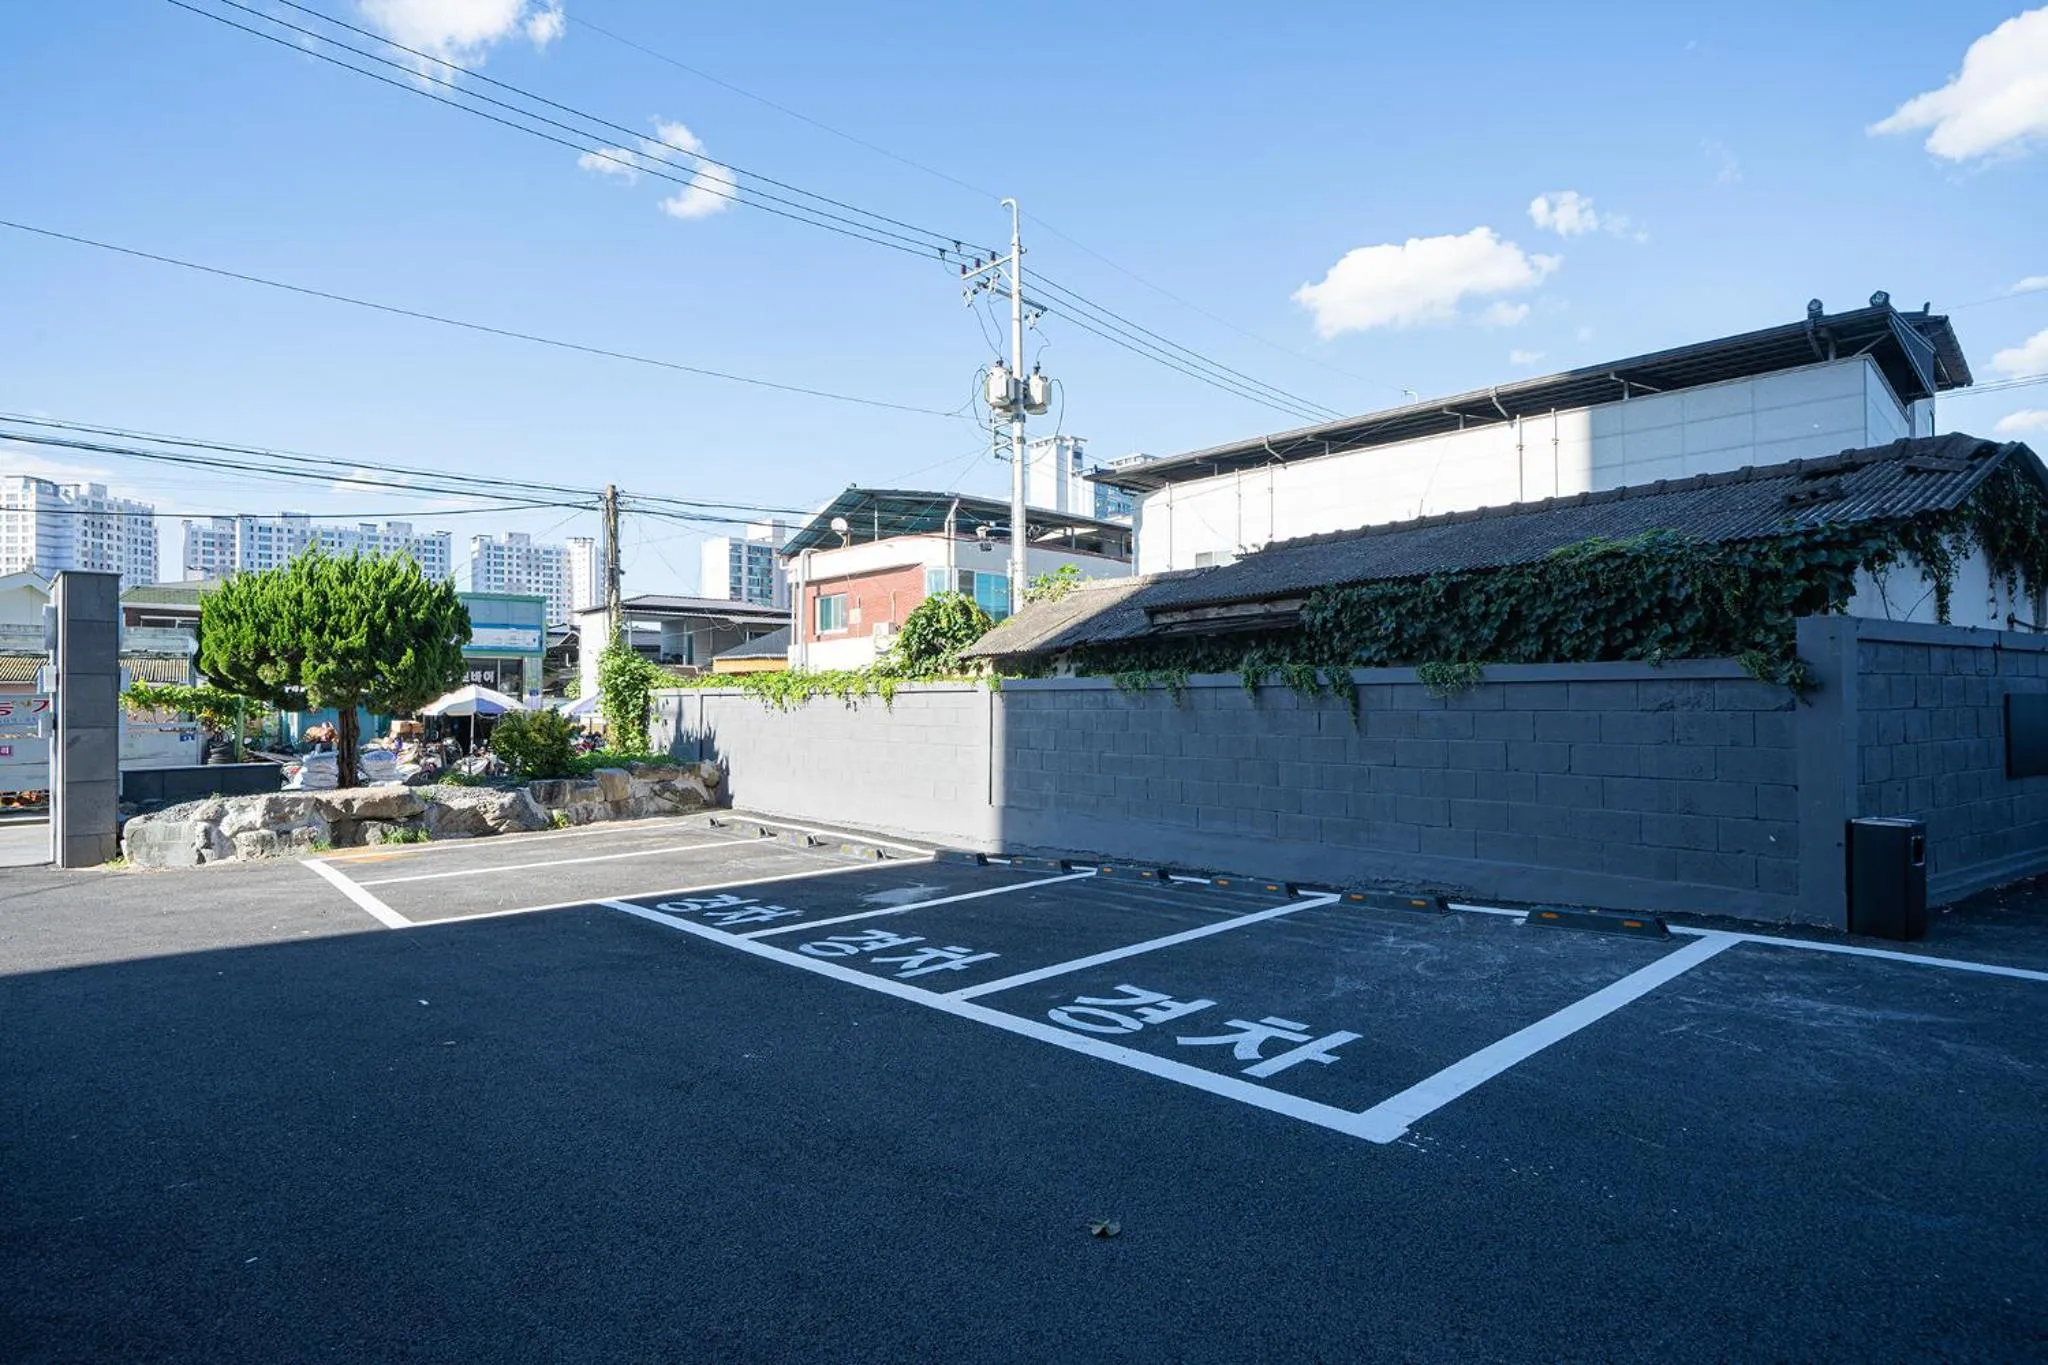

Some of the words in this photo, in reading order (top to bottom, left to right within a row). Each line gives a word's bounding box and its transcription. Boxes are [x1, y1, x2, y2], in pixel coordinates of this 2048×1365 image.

[656, 893, 804, 927] 경차
[798, 929, 1002, 978] 경차
[1047, 984, 1363, 1078] 경차
